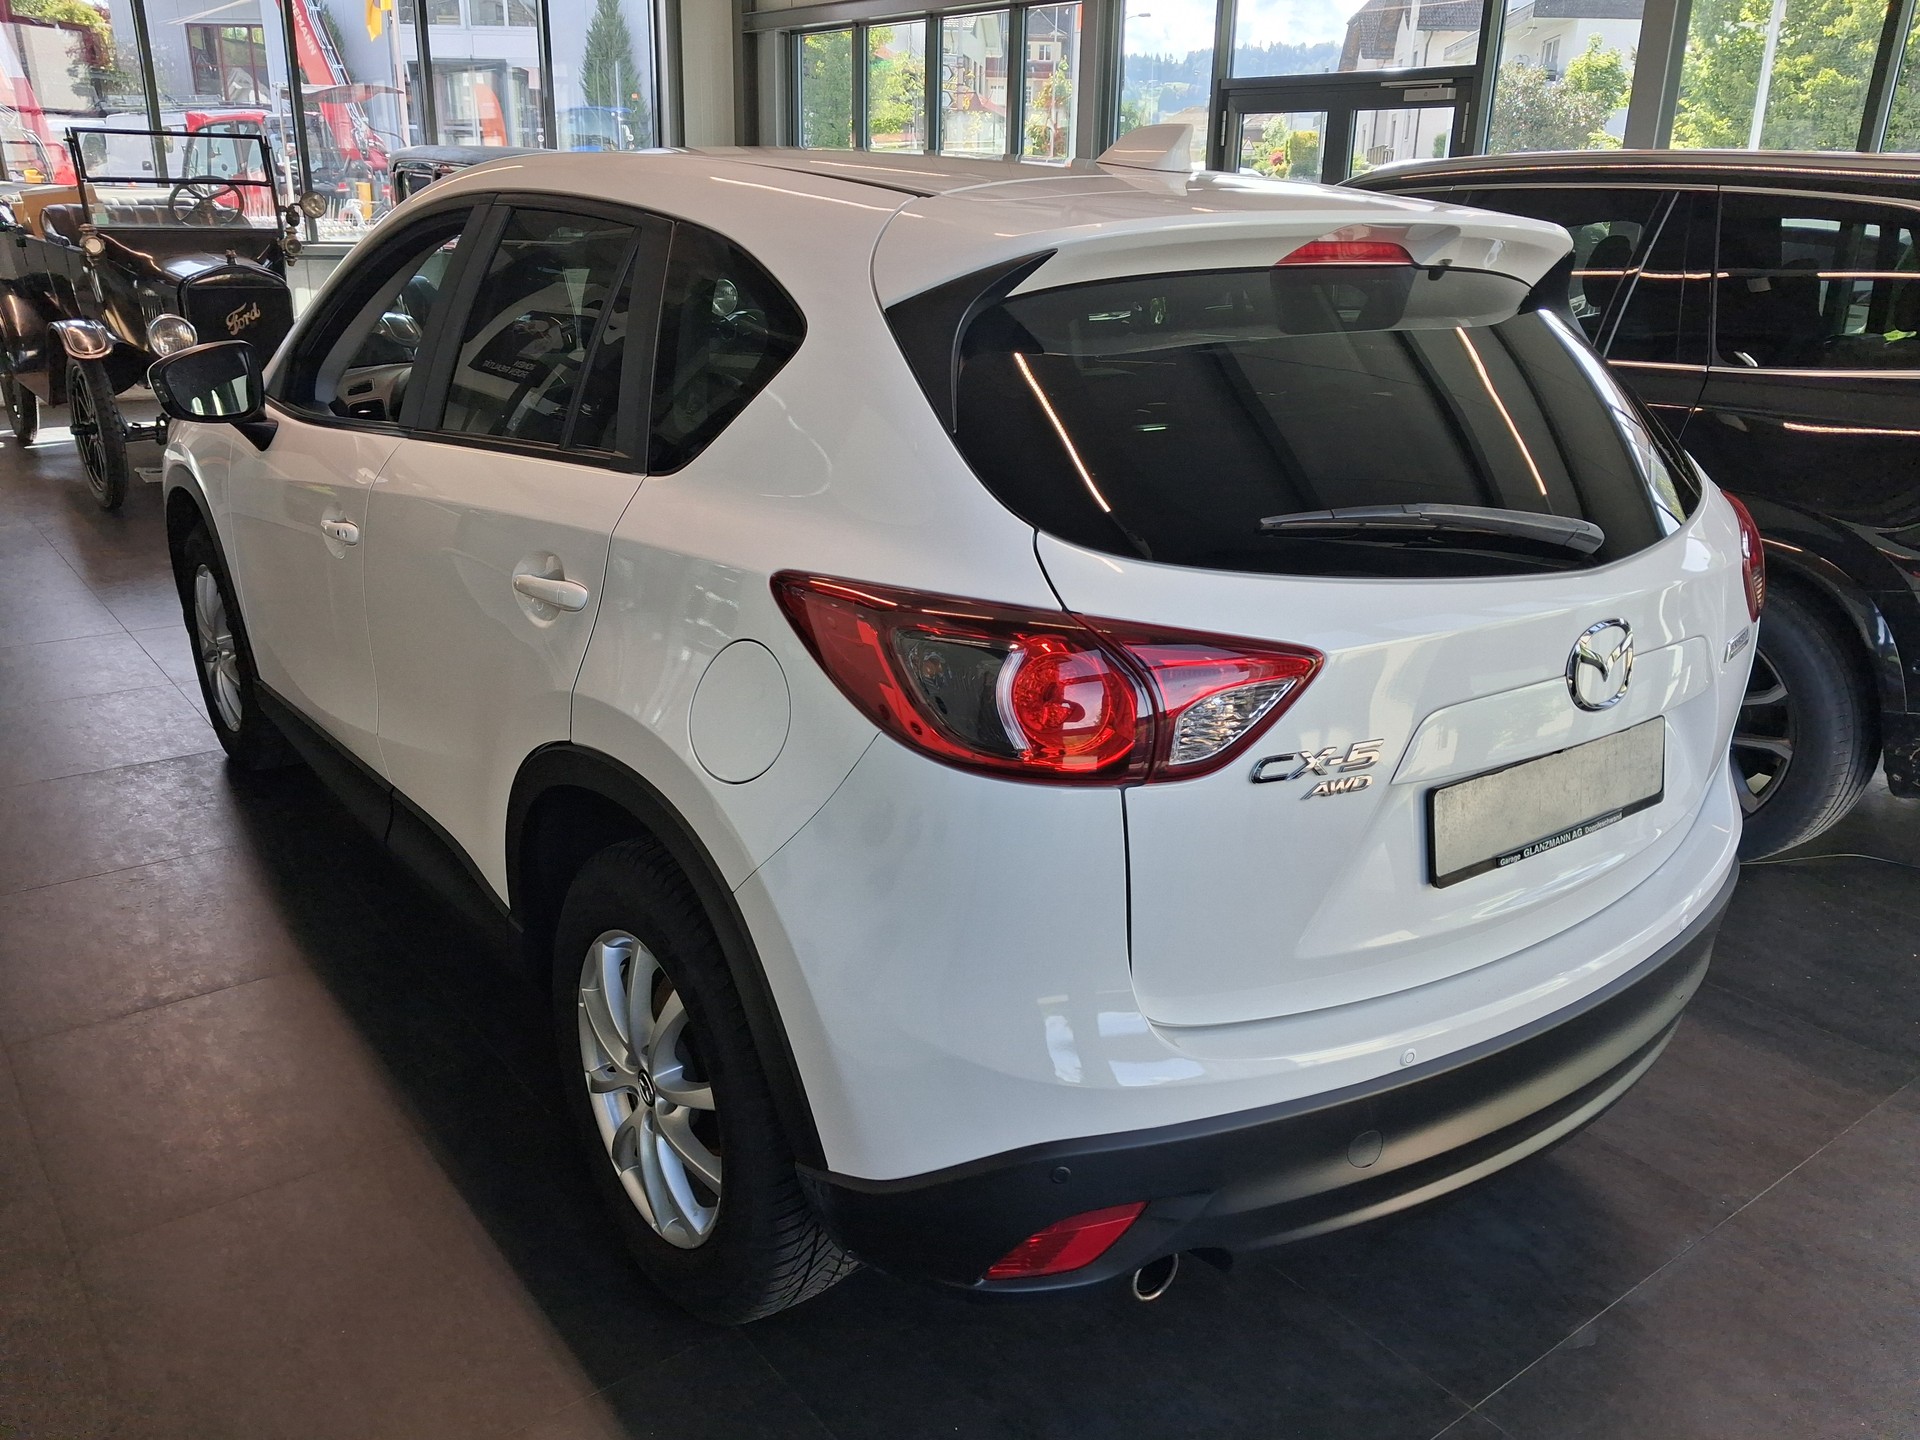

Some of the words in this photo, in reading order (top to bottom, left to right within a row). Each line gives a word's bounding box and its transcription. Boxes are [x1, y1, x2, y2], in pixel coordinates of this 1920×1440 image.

[226, 302, 261, 336] Ford
[1249, 738, 1384, 784] CX-5
[1300, 774, 1373, 800] AWD
[1500, 854, 1521, 867] Garage
[1523, 832, 1571, 858] GLANZMANN
[1572, 827, 1583, 841] AG
